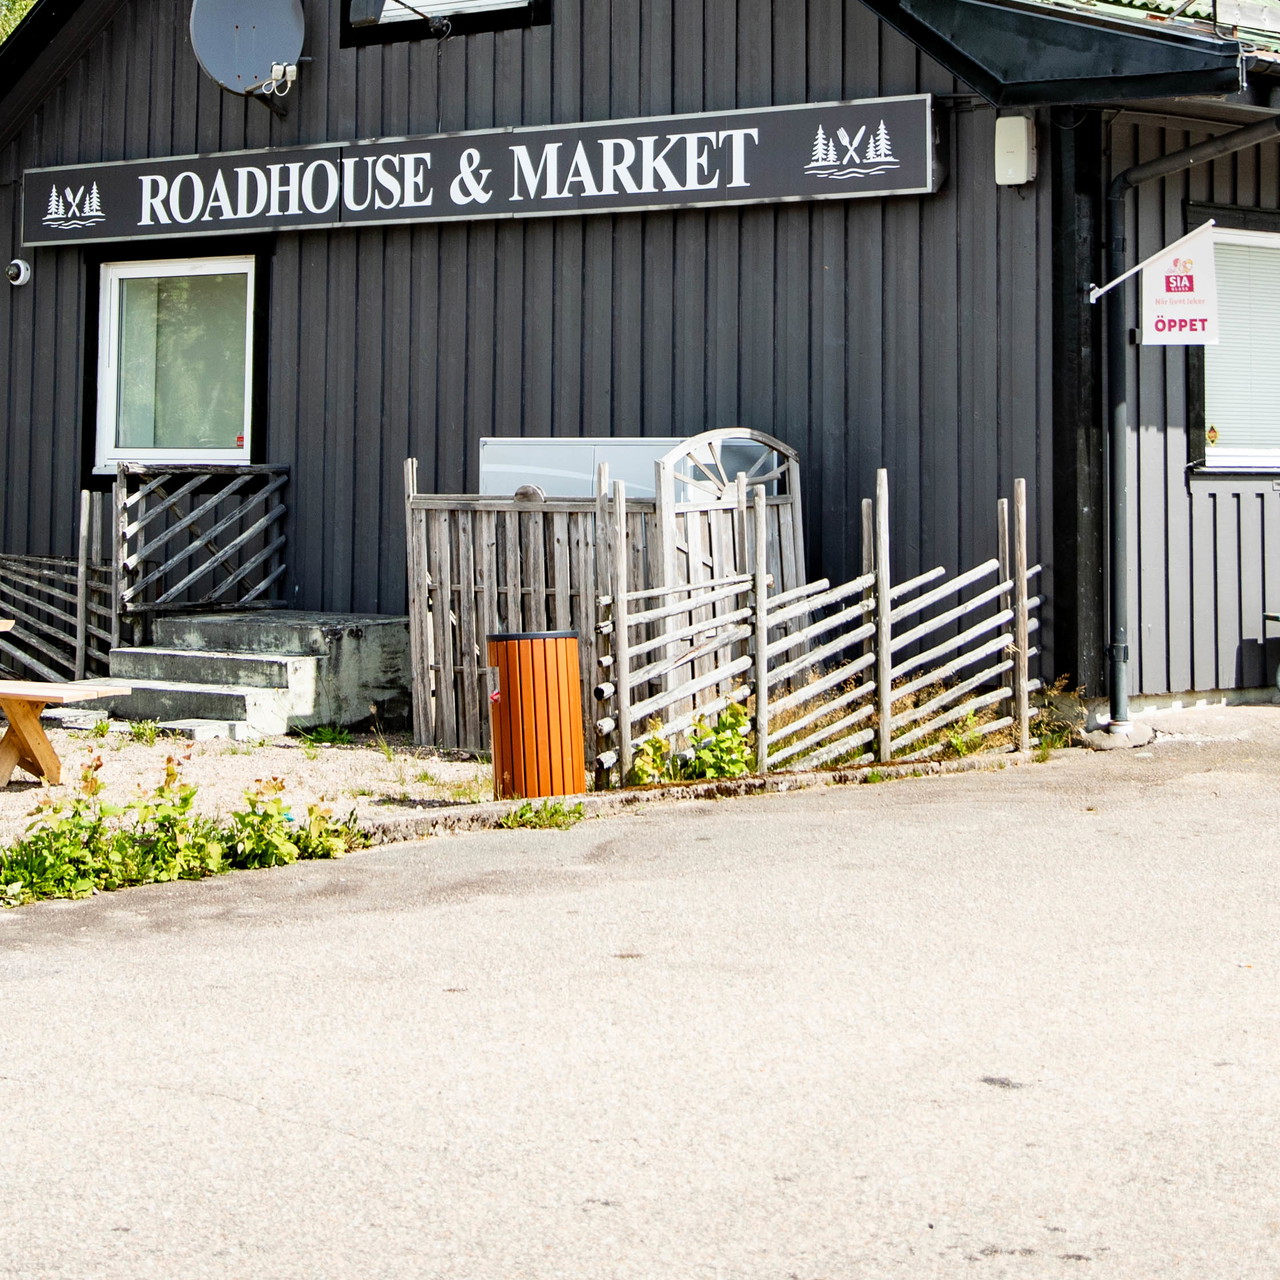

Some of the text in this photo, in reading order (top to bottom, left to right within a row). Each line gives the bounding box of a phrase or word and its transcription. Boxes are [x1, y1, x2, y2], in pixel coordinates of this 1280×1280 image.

[137, 127, 759, 227] ROADHOUSE & MARKET
[1169, 276, 1190, 287] SIA
[1154, 315, 1208, 332] ÖPPET
